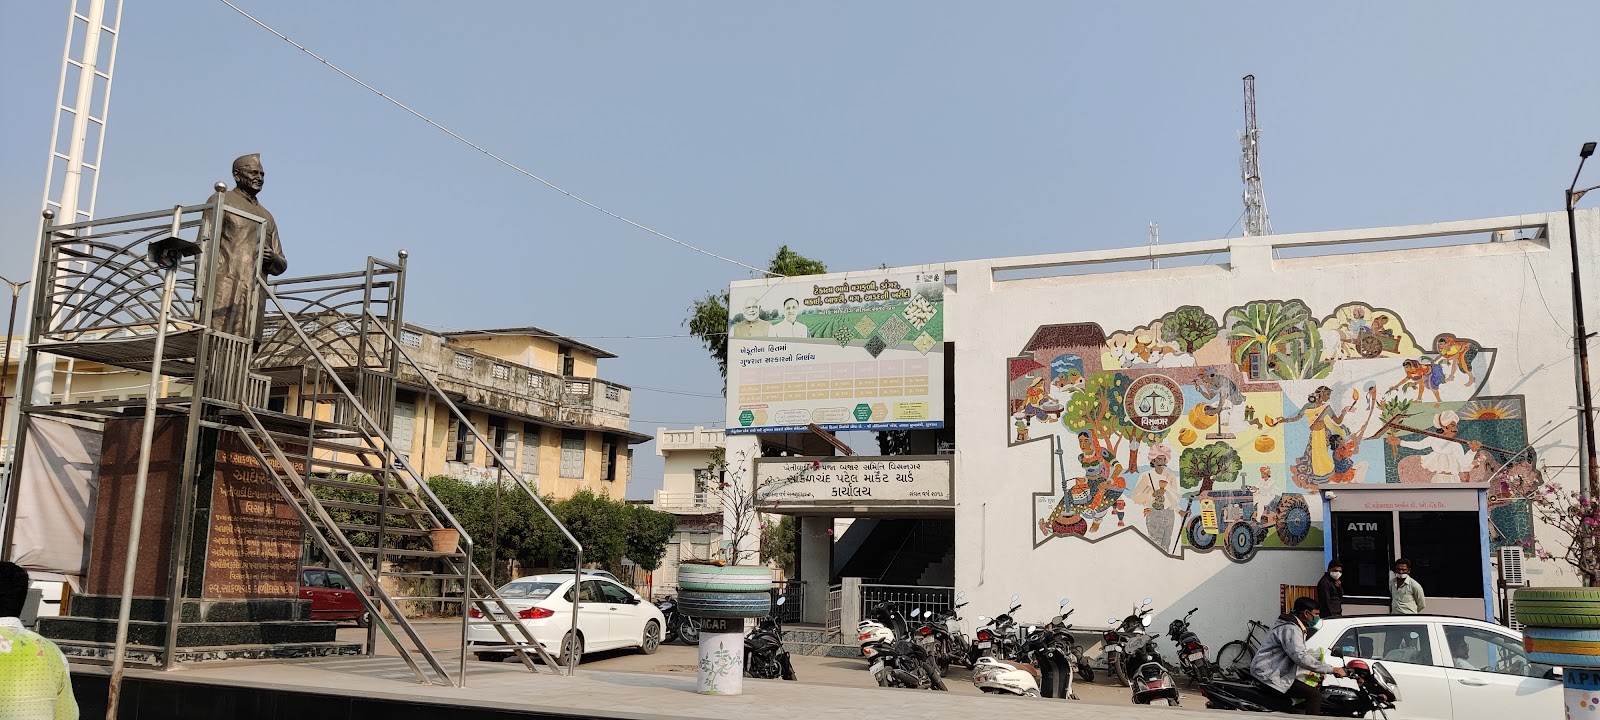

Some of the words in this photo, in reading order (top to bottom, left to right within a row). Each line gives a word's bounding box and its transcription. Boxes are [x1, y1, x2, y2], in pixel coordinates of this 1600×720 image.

[740, 345, 765, 356] ખેડૂતોના
[768, 343, 787, 353] હિતમાં
[740, 357, 762, 368] ગુજરાત
[765, 353, 793, 364] સરકારનો
[795, 352, 816, 361] નિર્ણય
[1141, 416, 1168, 426] વિસનગર
[888, 461, 921, 470] વિસનગર
[836, 471, 859, 483] પટેલ
[863, 470, 889, 483] માર્કેટ
[896, 470, 914, 483] યાર્ડ
[831, 483, 872, 497] કાર્યાલય
[1347, 522, 1378, 531] ATM
